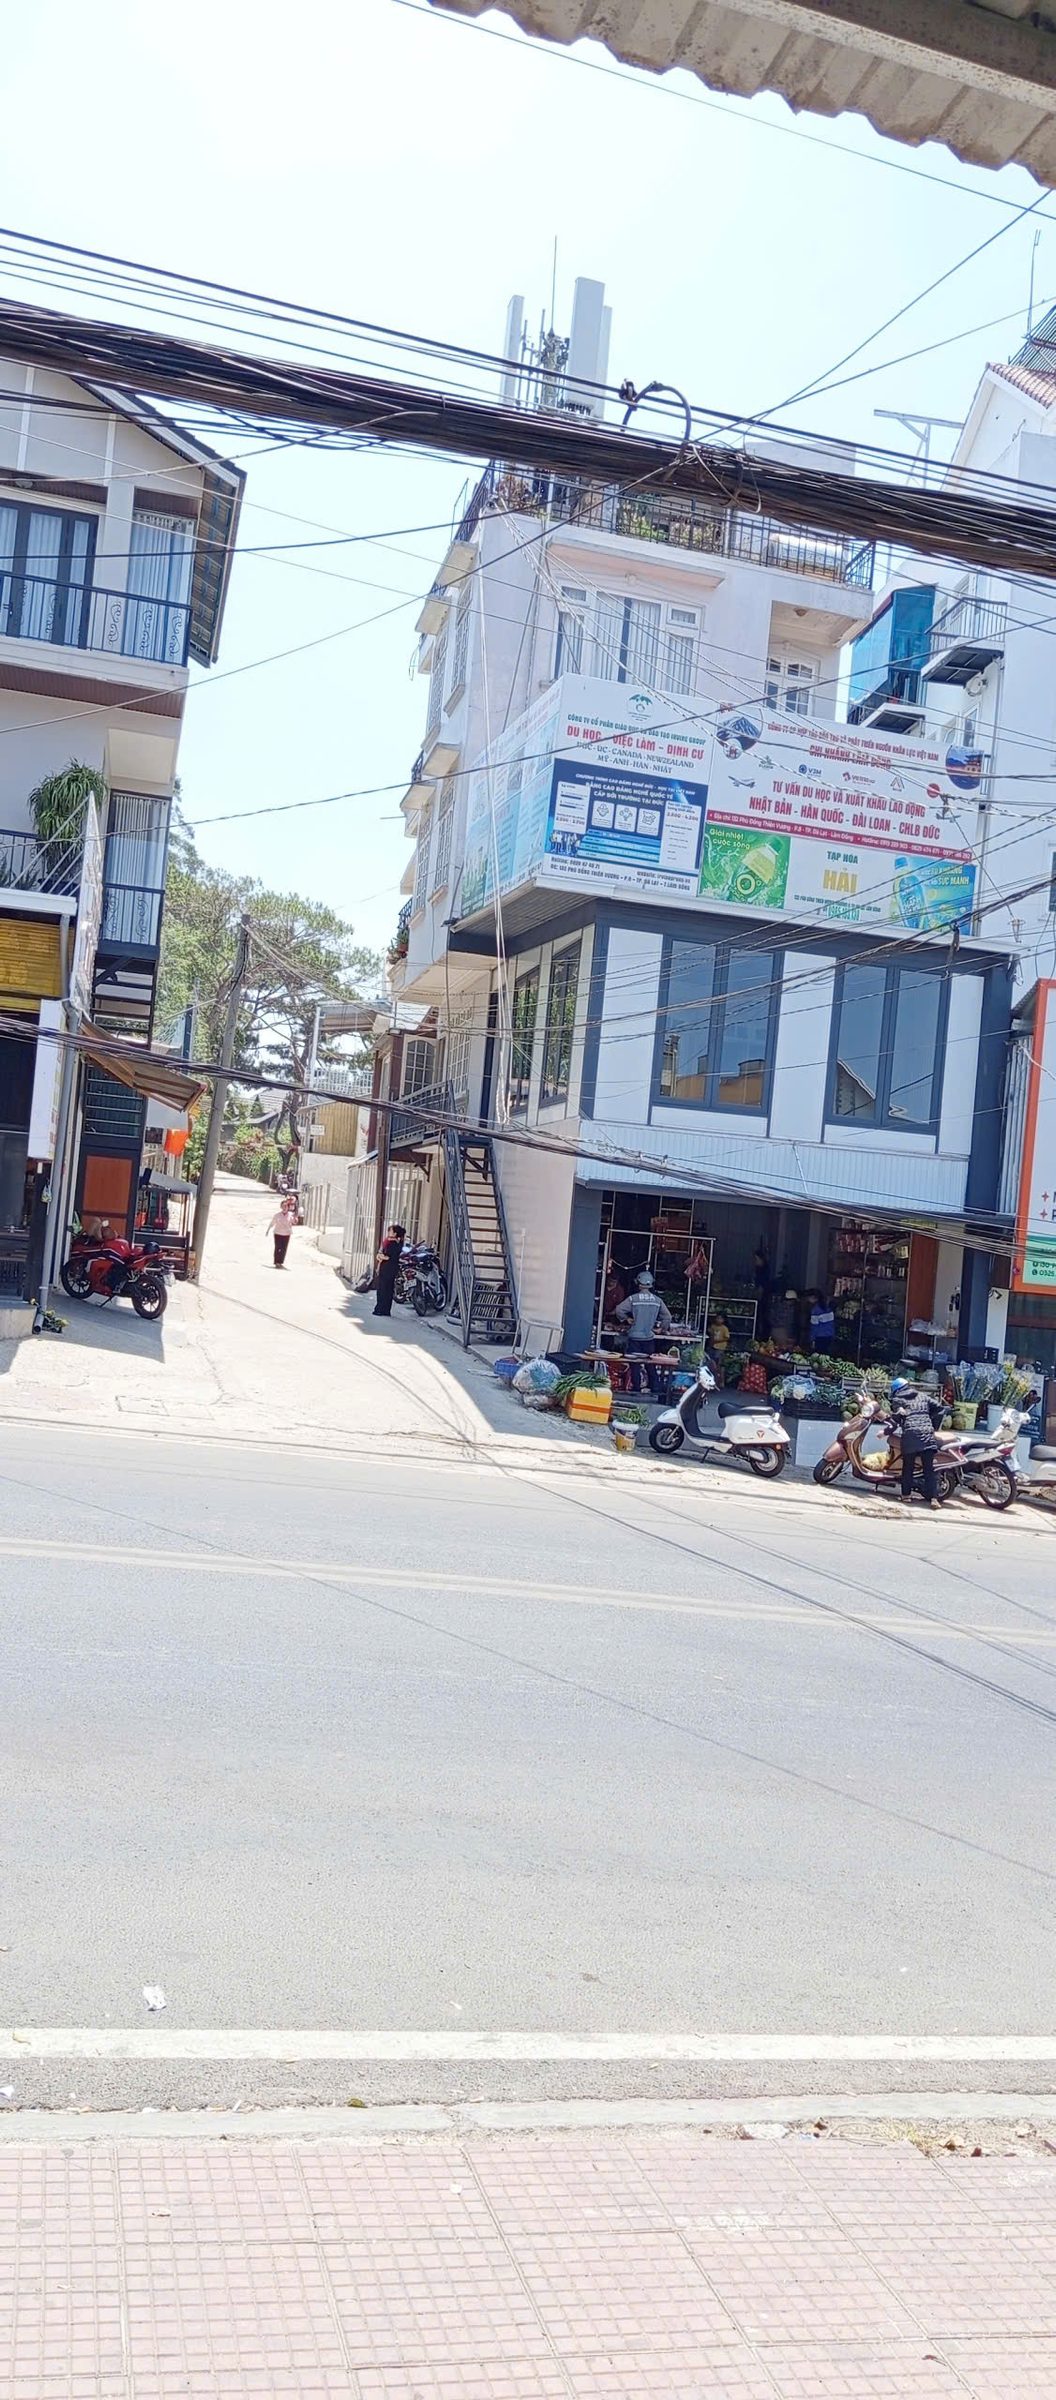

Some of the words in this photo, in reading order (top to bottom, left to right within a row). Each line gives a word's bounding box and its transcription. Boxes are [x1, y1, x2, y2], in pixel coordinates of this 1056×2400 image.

[567, 725, 580, 737] DU
[636, 736, 656, 750] LÀM
[612, 747, 643, 760] CANADA
[646, 755, 695, 769] NEWZEALAND
[612, 757, 630, 768] ANH
[927, 752, 939, 761] NAM
[772, 780, 783, 793] TƯ
[785, 781, 801, 796] VẤN
[802, 787, 813, 798] DU
[814, 788, 831, 803] HỌC
[888, 801, 903, 815] LAO
[905, 801, 926, 818] ĐỘNG
[749, 796, 772, 814] NHẬT
[774, 797, 793, 816] BẢN
[800, 802, 819, 820] HÀN
[820, 805, 844, 824] QUỐC
[852, 811, 867, 828] ĐÀI
[868, 816, 891, 832] LOAN
[898, 821, 921, 837] CHLB
[922, 824, 941, 840] ĐỨC
[827, 850, 842, 863] TẠP
[824, 868, 858, 893] HẢI
